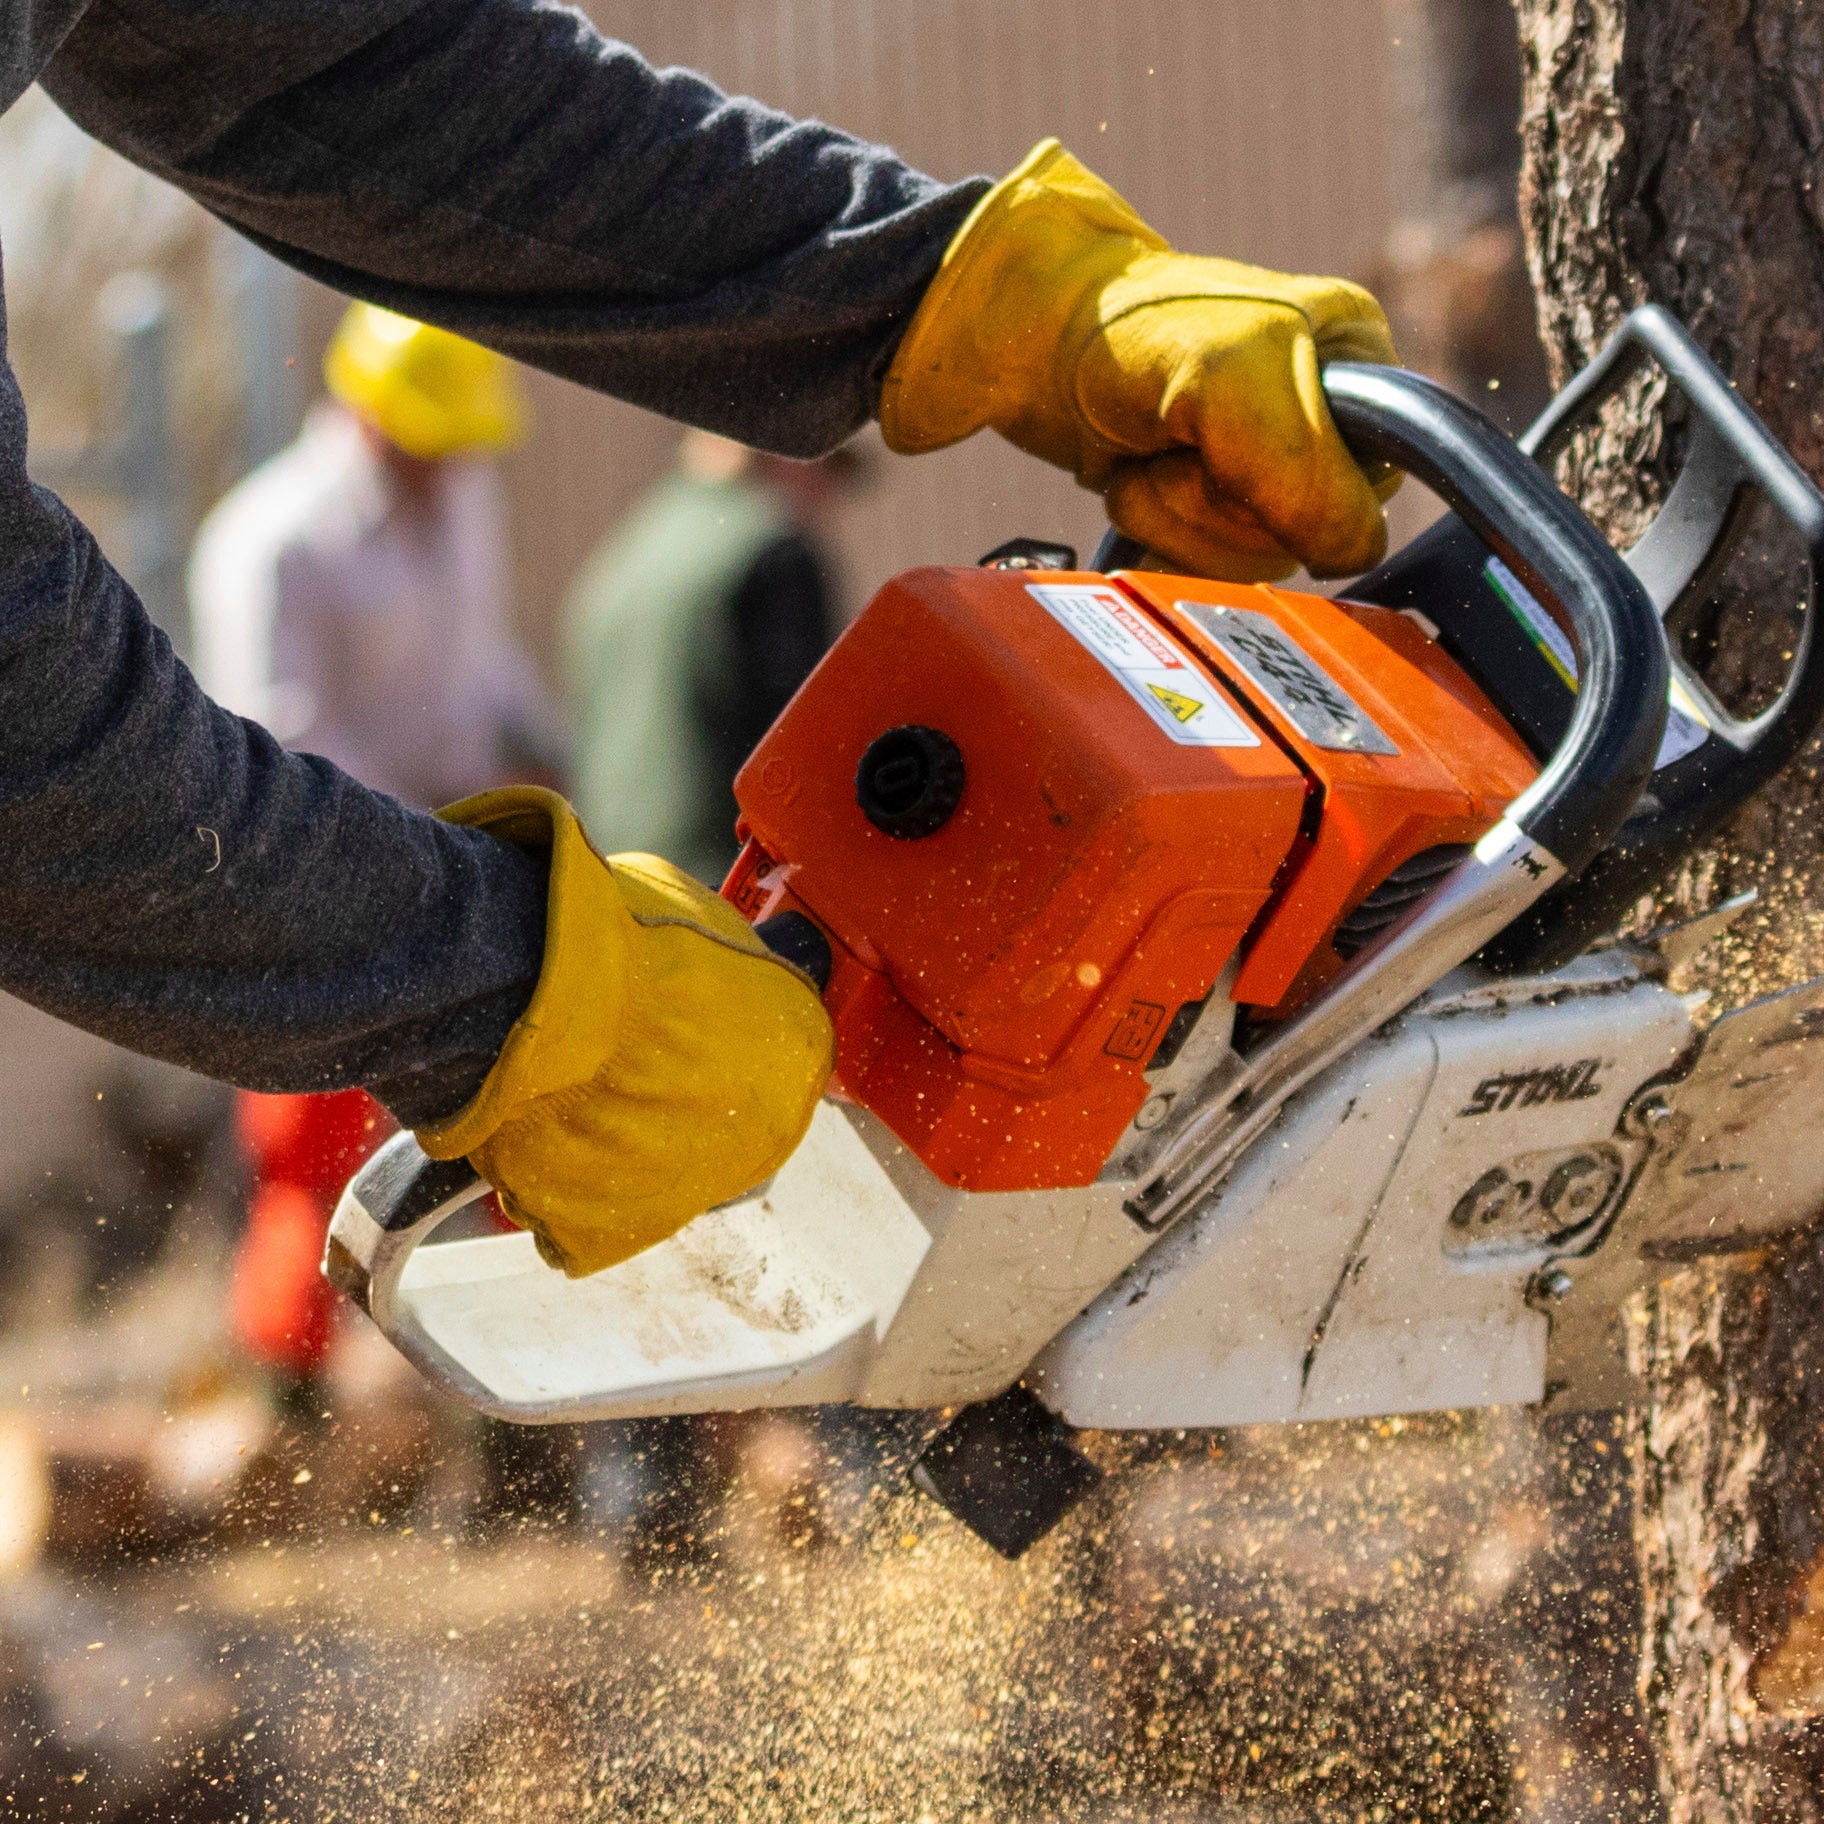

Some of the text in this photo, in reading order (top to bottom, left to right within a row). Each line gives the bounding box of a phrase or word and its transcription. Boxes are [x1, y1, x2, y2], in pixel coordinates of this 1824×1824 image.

[1113, 611, 1176, 664] DANGER
[1247, 628, 1358, 728] STIHL
[1458, 1058, 1603, 1118] STIHL
